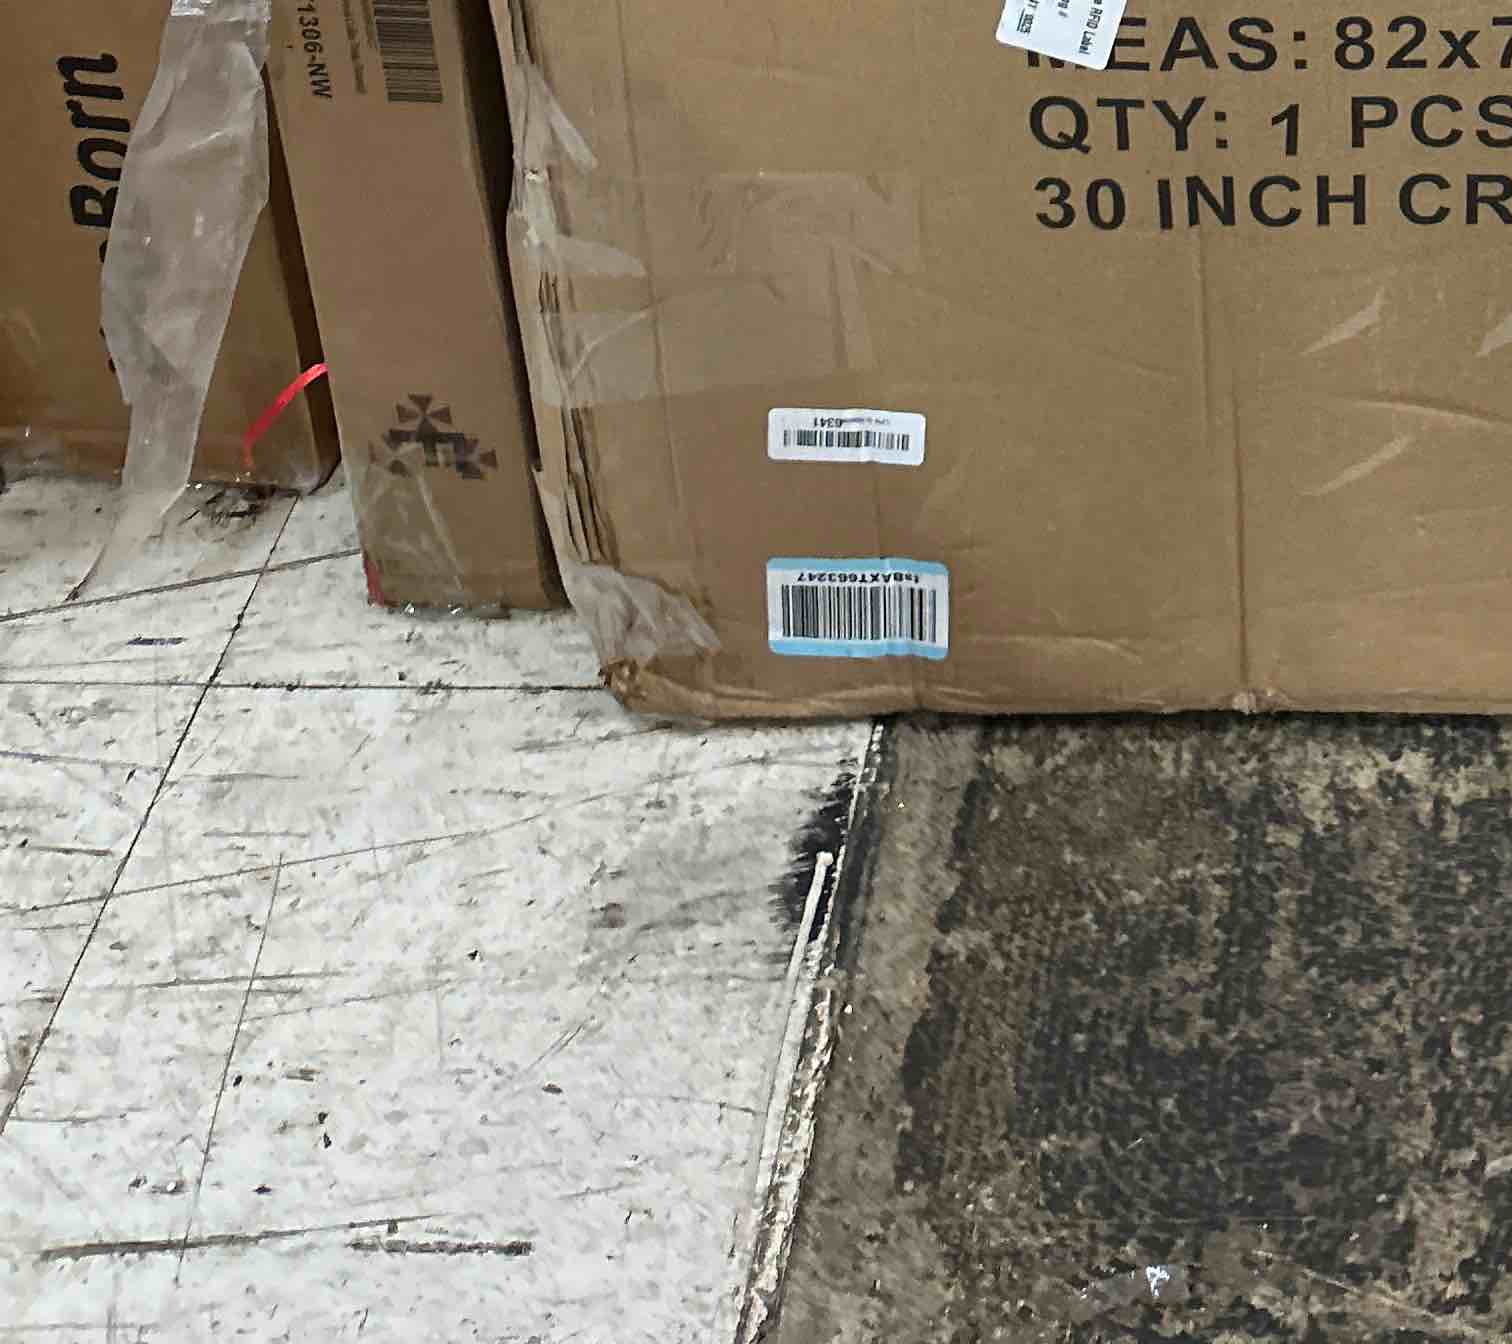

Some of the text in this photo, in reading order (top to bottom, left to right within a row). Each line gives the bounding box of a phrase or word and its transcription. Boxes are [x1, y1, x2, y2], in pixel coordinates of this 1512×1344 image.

[1024, 16, 1308, 72] EAS:
[1079, 30, 1096, 55] Label
[1086, 6, 1103, 31] RFID
[1029, 95, 1229, 155] QTY:
[1270, 103, 1299, 157] 1
[1034, 177, 1127, 231] 30
[1157, 174, 1367, 229] INCH
